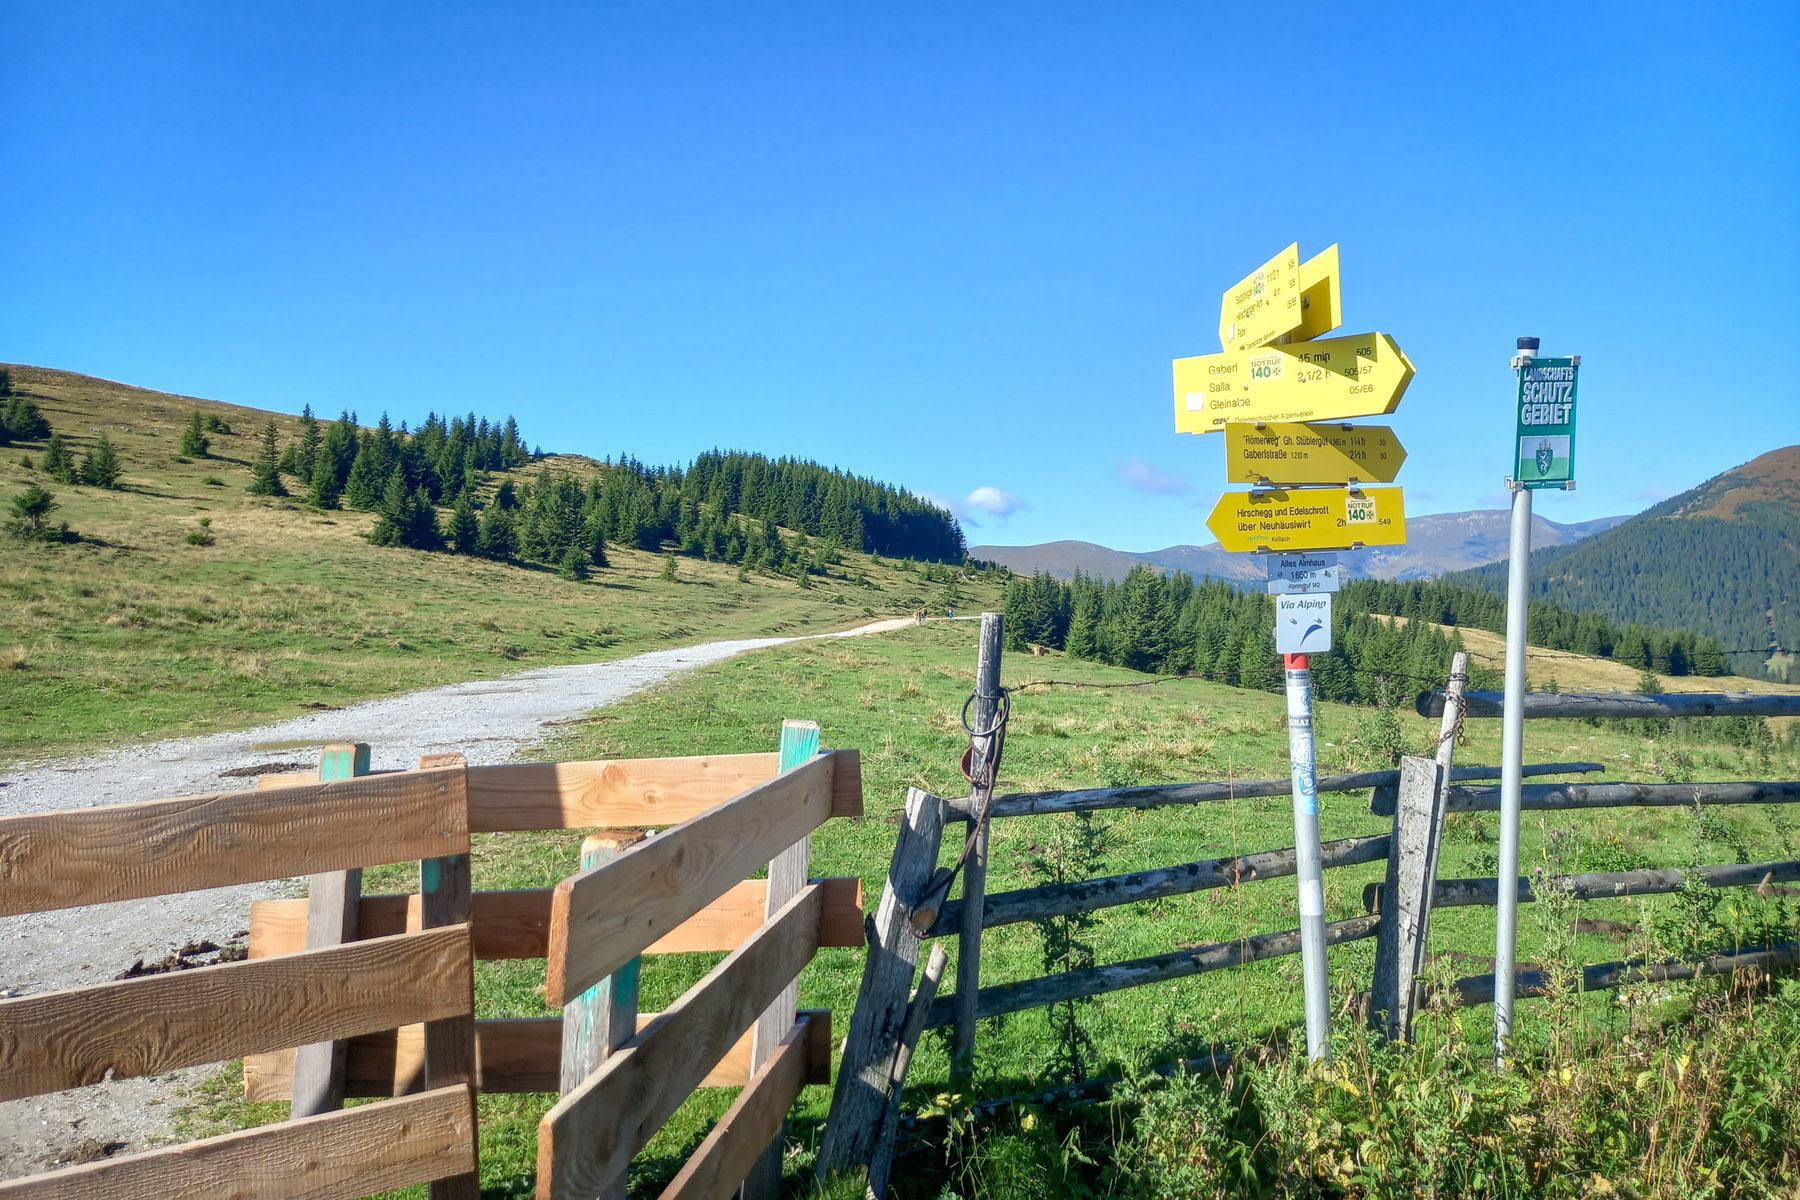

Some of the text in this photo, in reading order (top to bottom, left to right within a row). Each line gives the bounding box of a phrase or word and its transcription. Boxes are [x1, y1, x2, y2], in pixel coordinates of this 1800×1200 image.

[1298, 351, 1330, 363] 45 min
[1356, 347, 1372, 356] 505
[1251, 358, 1281, 367] NOTRUF
[1208, 363, 1238, 374] Gaberl
[1251, 366, 1271, 379] 140
[1344, 366, 1373, 376] 505/57
[1307, 370, 1322, 381] 1/2
[1523, 367, 1574, 382] LANDSCHAFTS
[1209, 382, 1231, 393] Salla
[1349, 384, 1374, 394] 05/E6
[1522, 381, 1574, 404] SCHUTZ
[1210, 398, 1251, 410] Gleinalpe
[1521, 403, 1573, 425] GEBIET
[1283, 436, 1295, 446] Gh.
[1296, 435, 1328, 448] Stüblergut
[1243, 449, 1287, 459] Gaberlstraße
[1237, 505, 1329, 518] Hirschegg und Edelschrott
[1348, 509, 1366, 520] 140
[1238, 520, 1311, 531] über Neuhäuslwirt
[1336, 518, 1347, 527] 2h
[1298, 559, 1326, 567] Almhaus
[1291, 570, 1308, 579] 1650
[1280, 600, 1326, 610] Via Alpina
